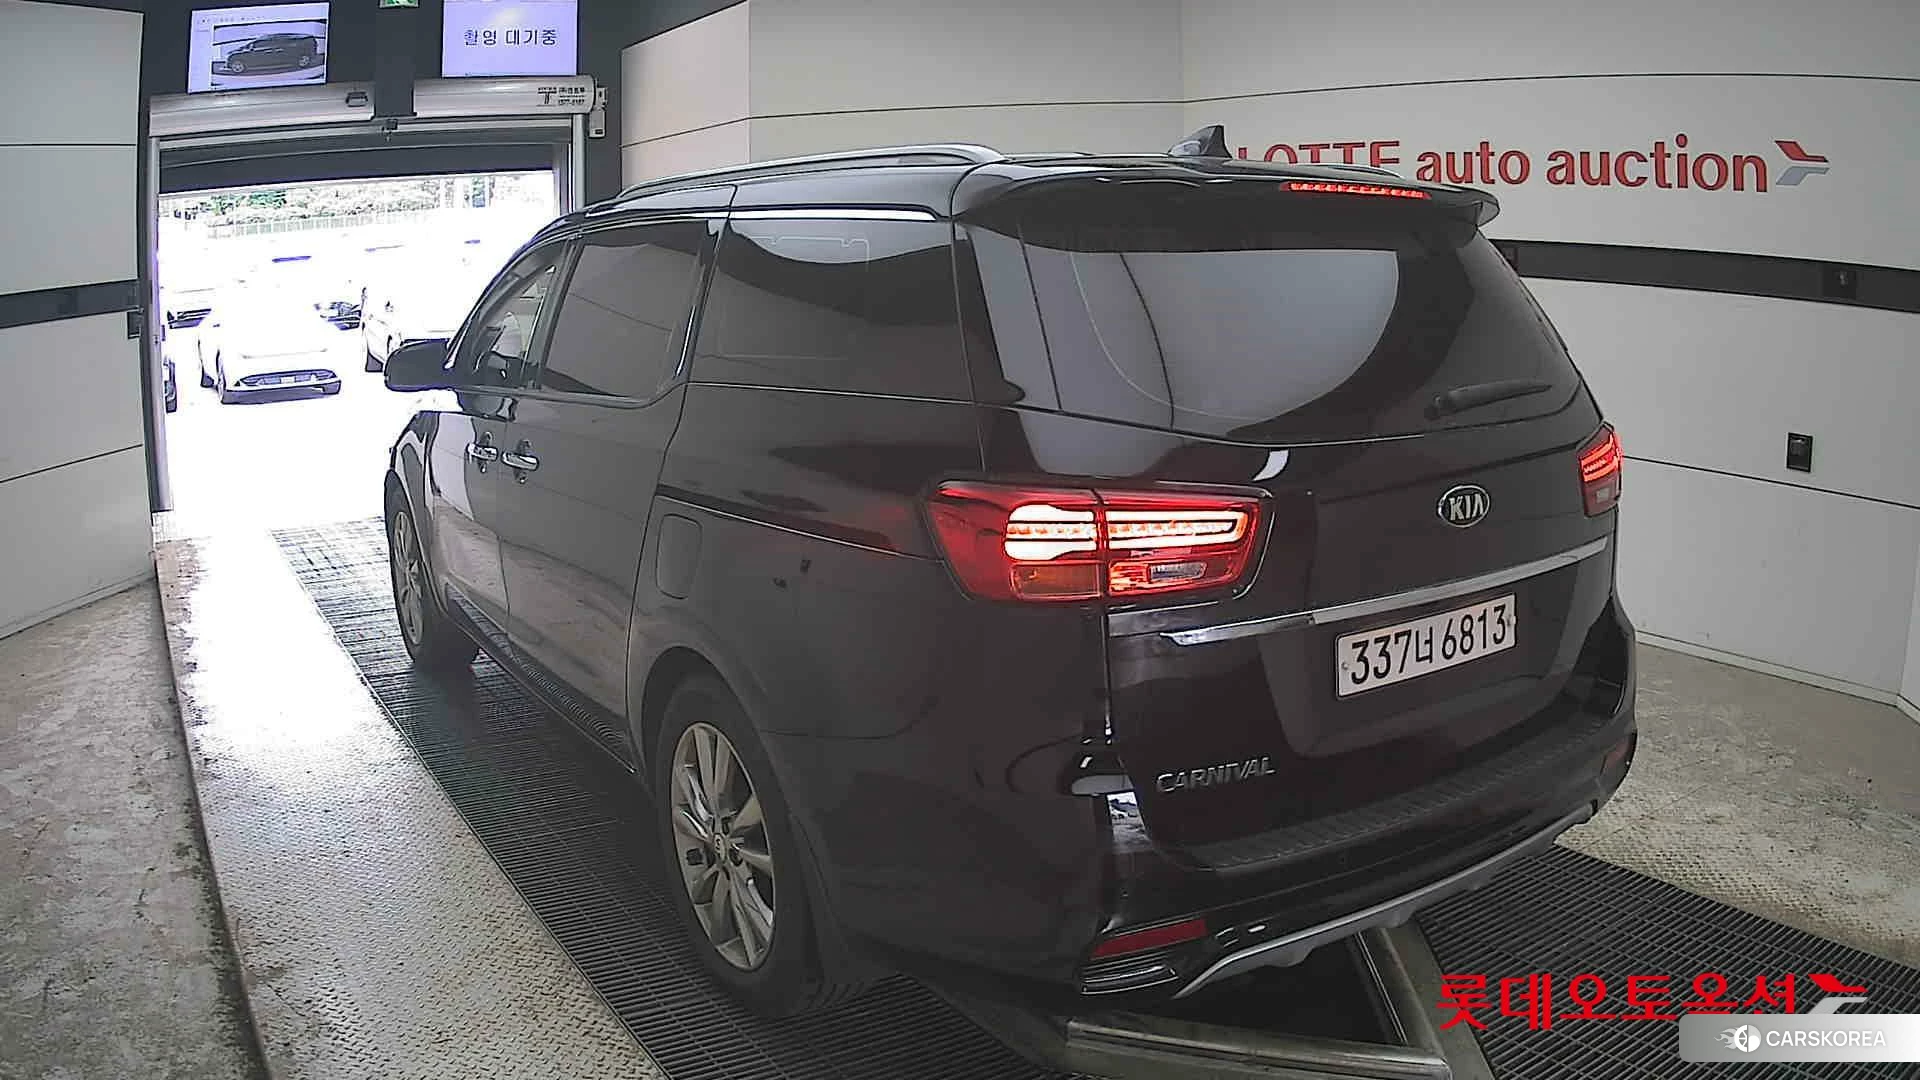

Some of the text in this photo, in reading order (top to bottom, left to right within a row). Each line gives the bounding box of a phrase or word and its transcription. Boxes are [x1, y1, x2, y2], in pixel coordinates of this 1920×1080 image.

[505, 28, 557, 46] 대기중
[1416, 141, 1531, 184] auto
[1547, 133, 1768, 193] auction
[1449, 493, 1484, 521] KIA
[1157, 757, 1276, 792] CARNIVAL
